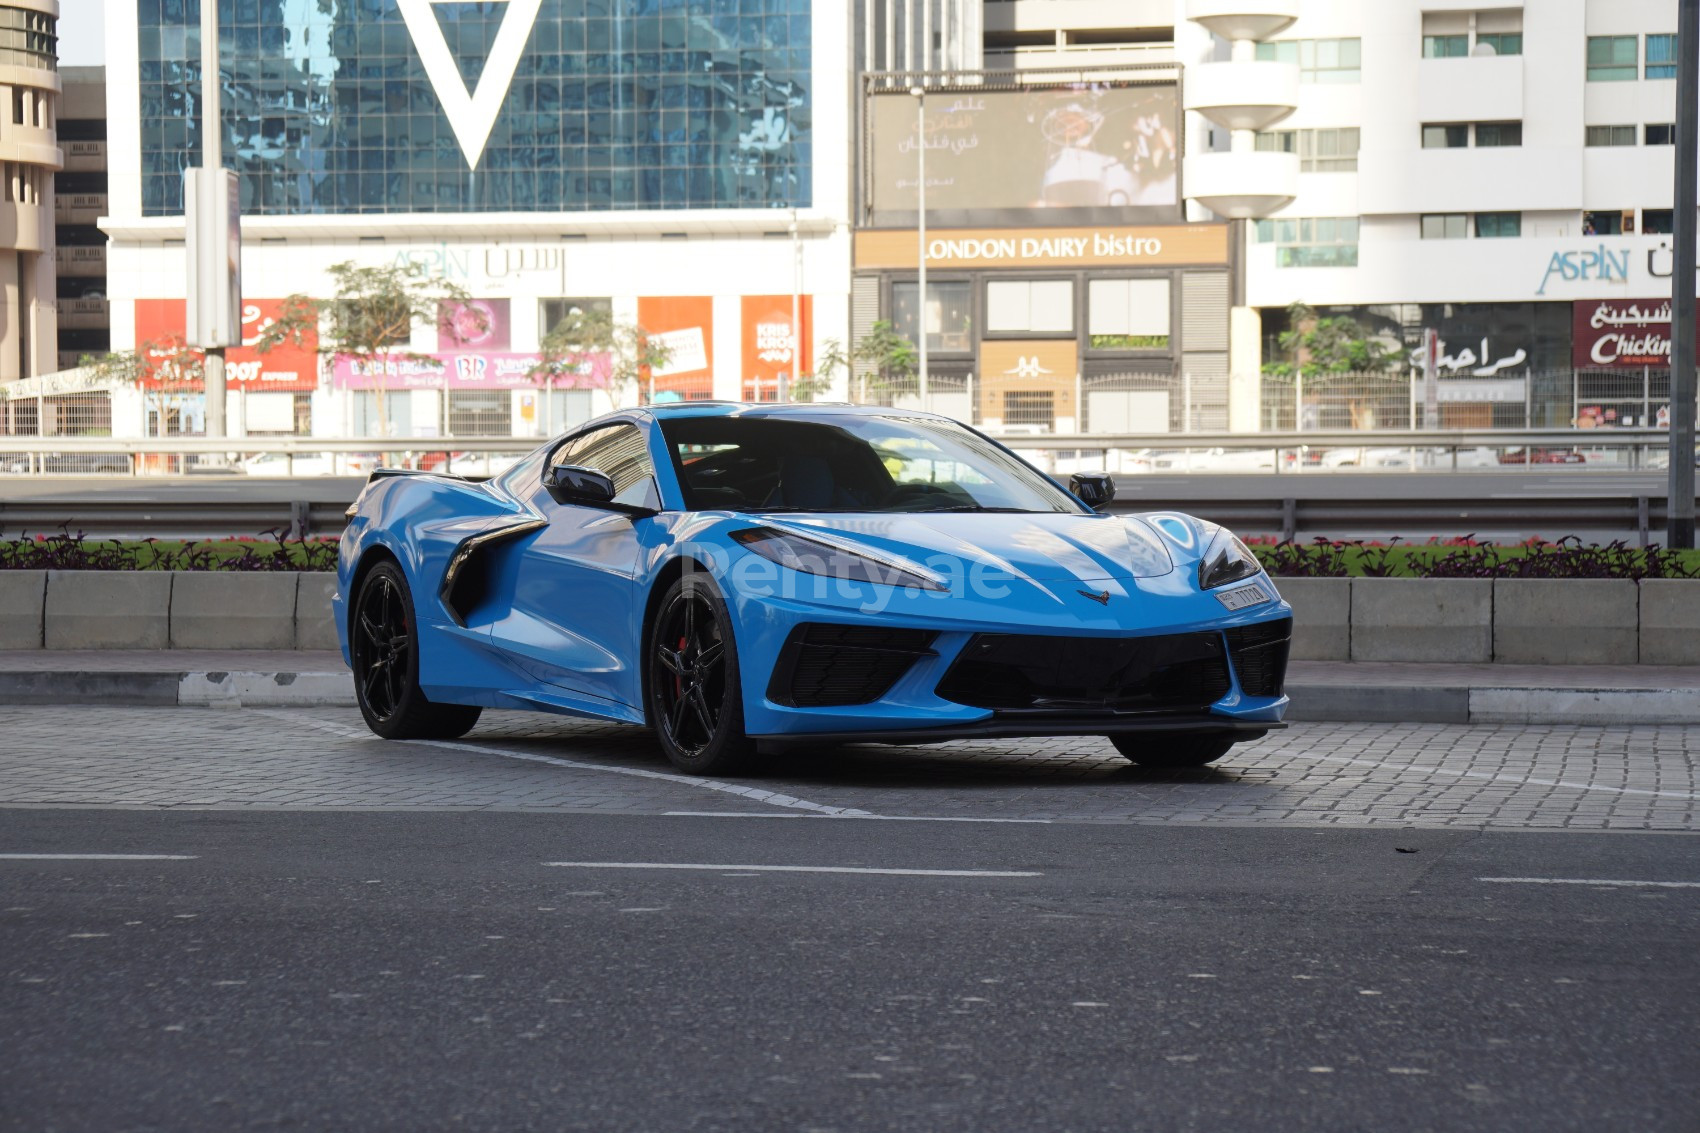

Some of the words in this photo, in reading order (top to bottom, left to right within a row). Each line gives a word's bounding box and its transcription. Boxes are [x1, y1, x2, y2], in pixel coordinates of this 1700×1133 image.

[924, 238, 1015, 260] ONDON
[1021, 236, 1089, 258] DAIRY
[1093, 232, 1162, 257] bistro
[1535, 243, 1630, 295] ASPIN
[758, 324, 790, 337] KRIS
[1590, 332, 1672, 364] Chickin
